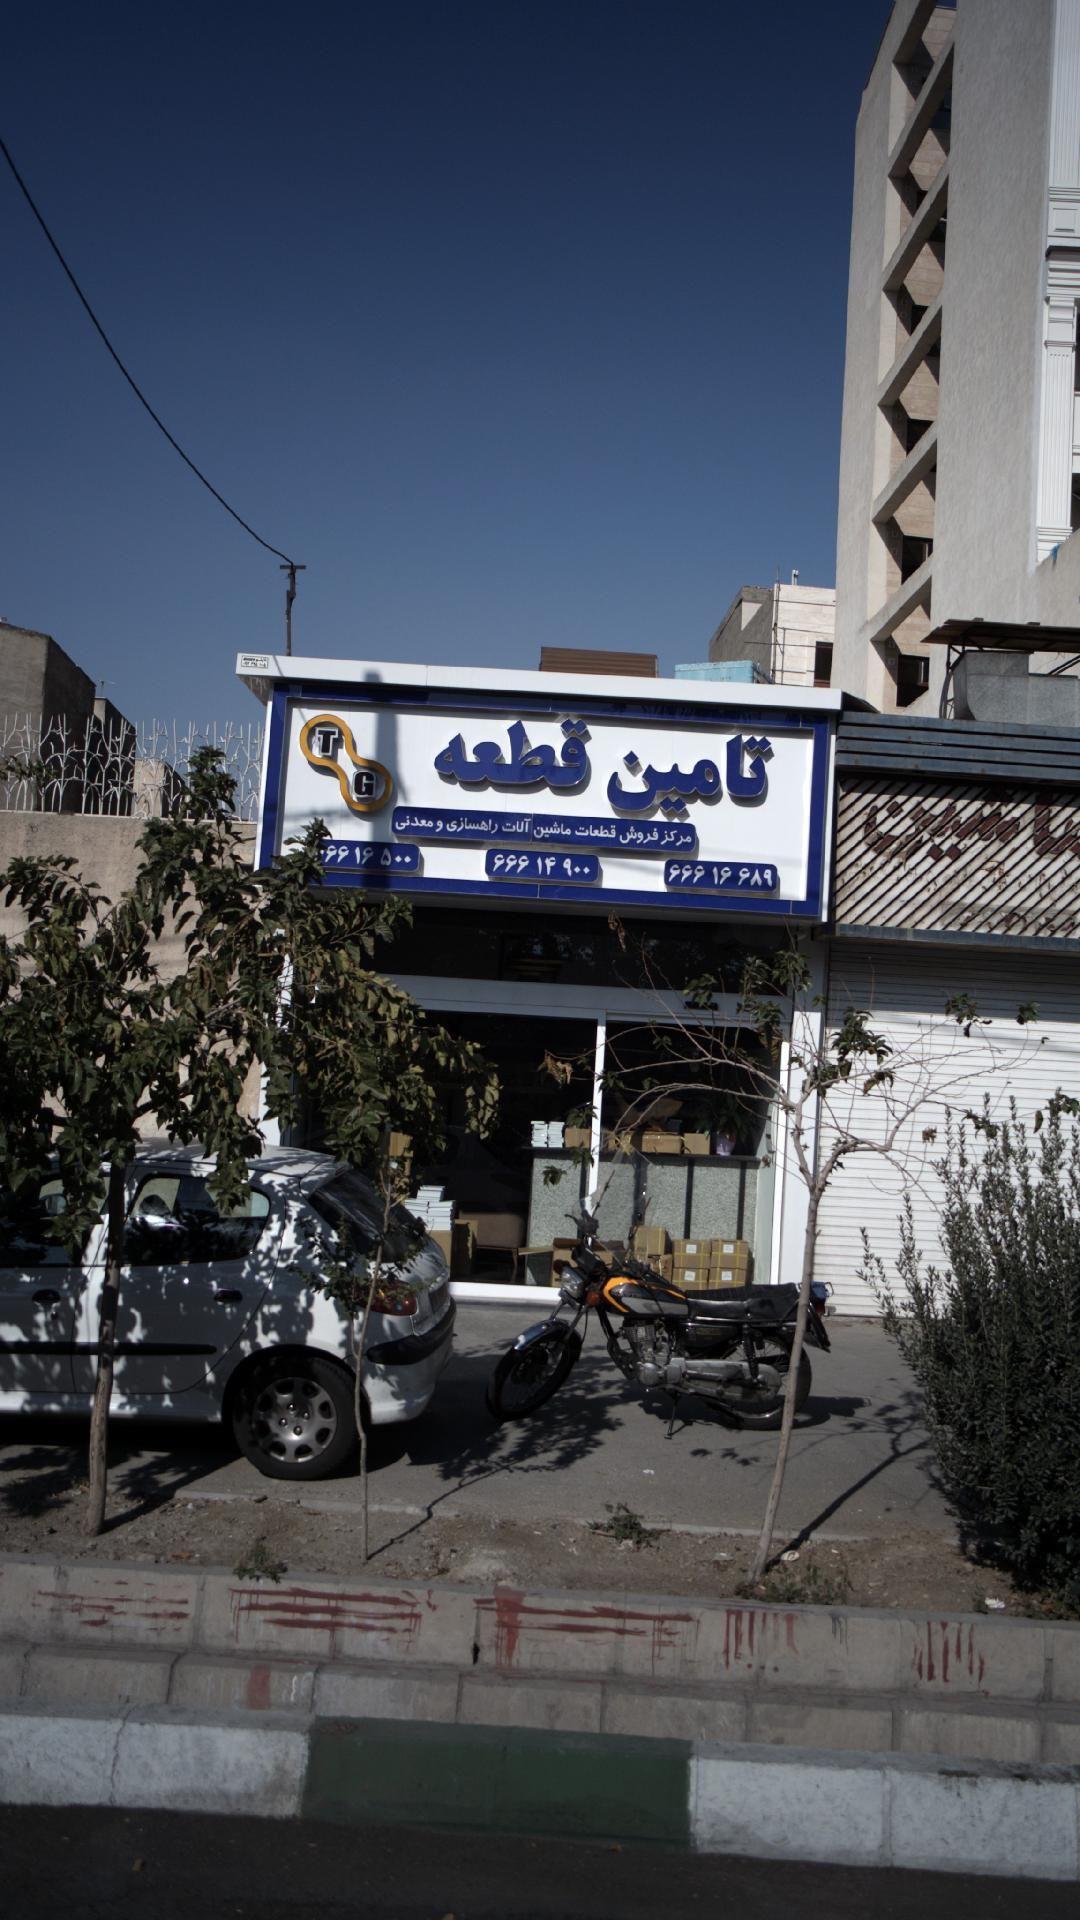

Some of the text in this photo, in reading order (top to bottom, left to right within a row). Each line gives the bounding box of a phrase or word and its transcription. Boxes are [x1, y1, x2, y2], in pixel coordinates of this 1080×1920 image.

[315, 727, 376, 798] T G
[433, 718, 772, 813] تامین قطعه
[395, 815, 692, 846] مرکز فروش قطعات ماشین آلات راهسازی و معدنی
[320, 845, 412, 866] ۶۶ ۱۶ ۵۰۰
[493, 854, 590, 877] ۶۶۶ ۱۴ ۹۰۰
[668, 864, 773, 887] ۶۶۶ ۱۶ ۶۸۹
